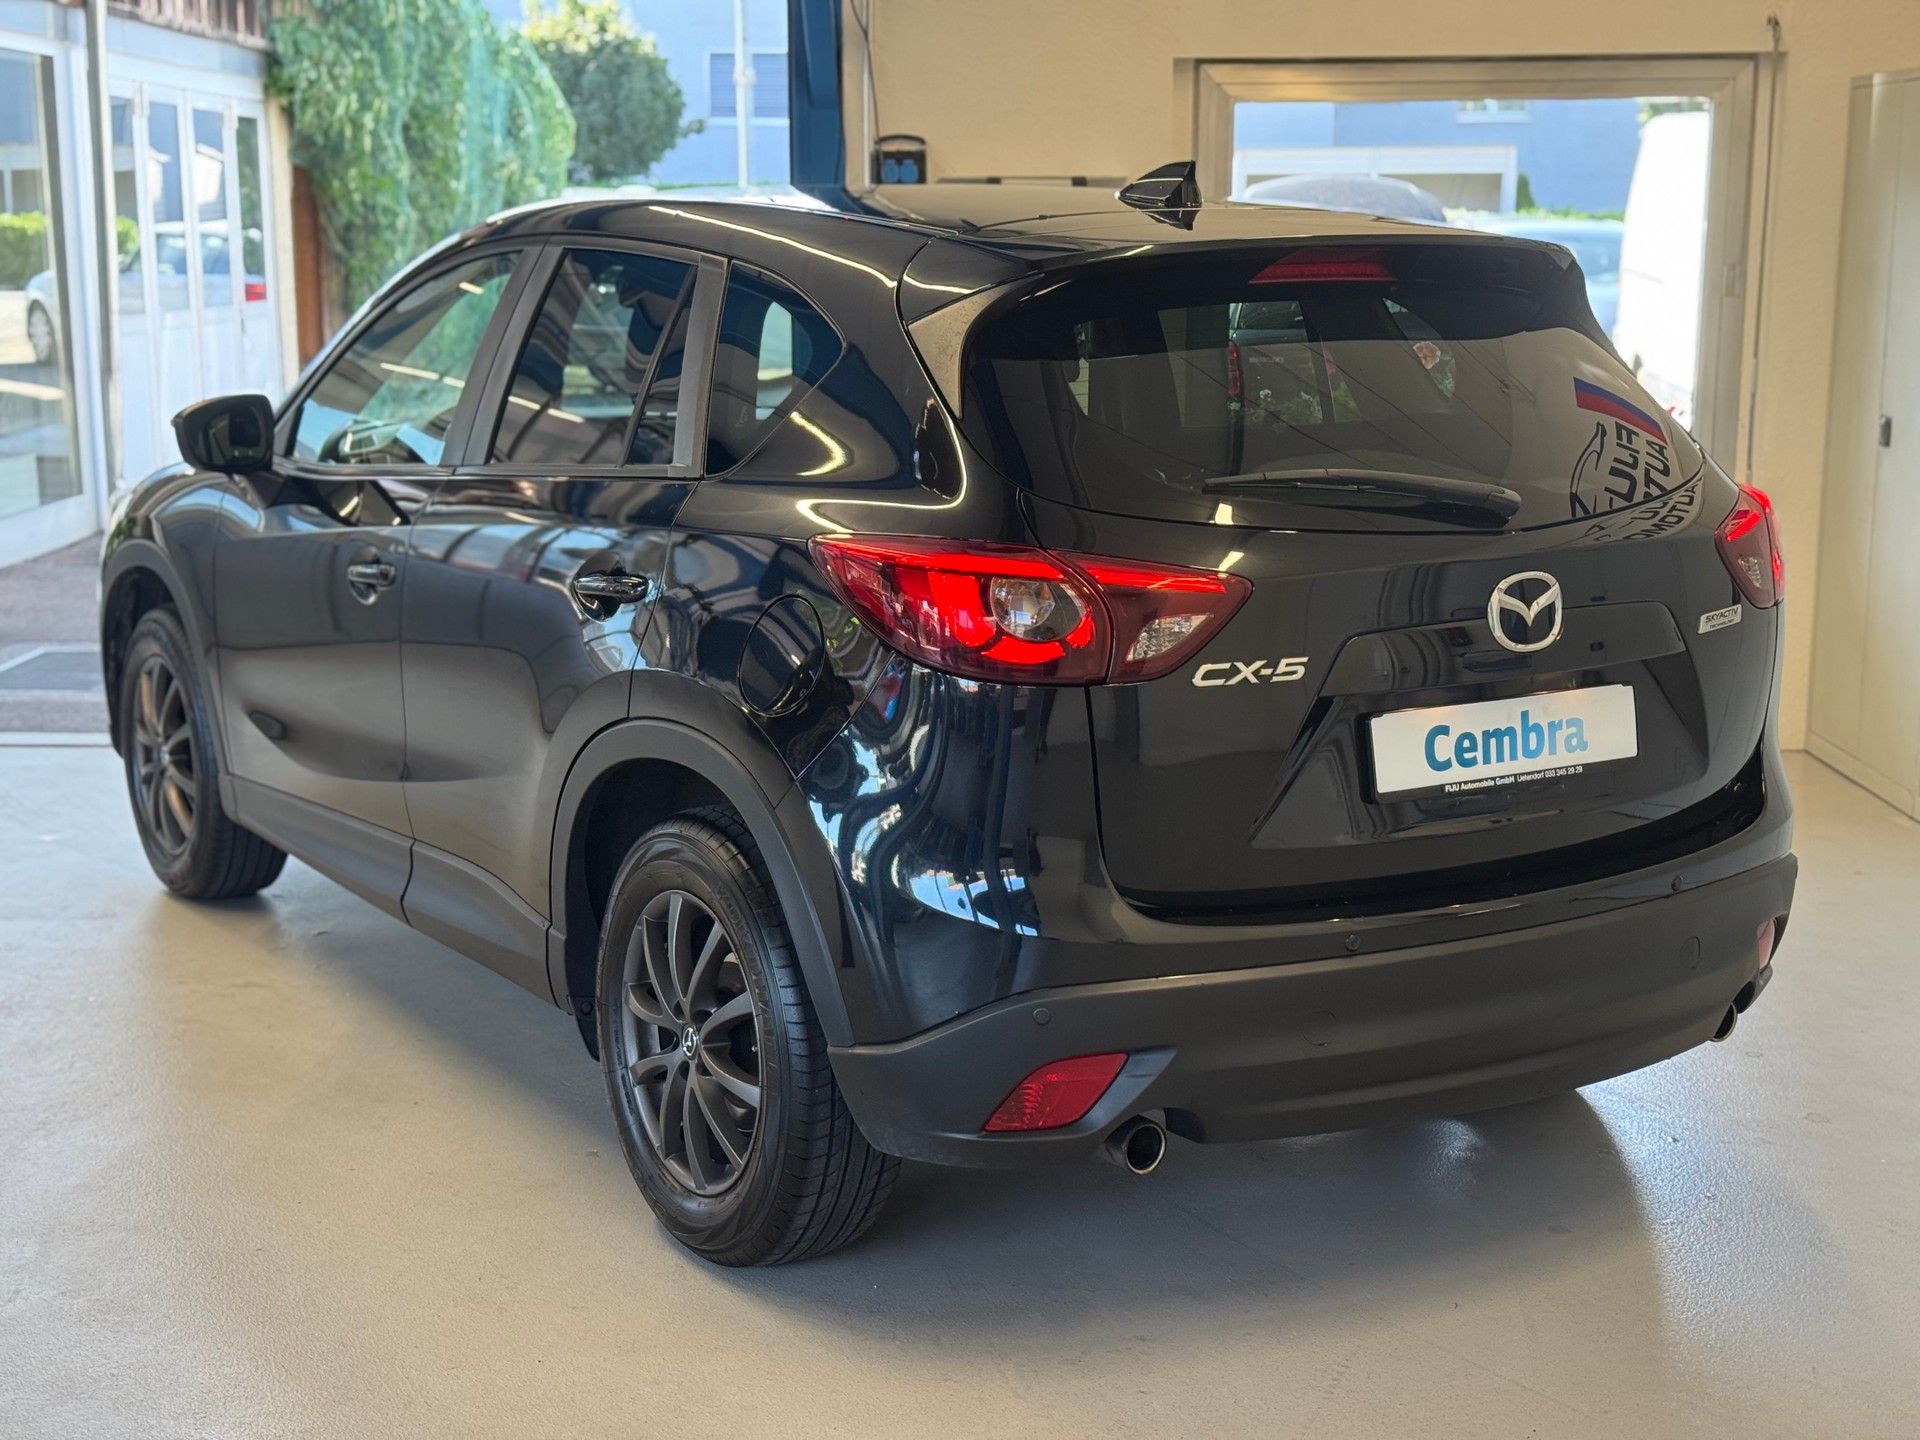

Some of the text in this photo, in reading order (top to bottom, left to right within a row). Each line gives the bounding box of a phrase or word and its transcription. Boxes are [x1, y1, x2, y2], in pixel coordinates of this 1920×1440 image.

[1192, 656, 1309, 687] CX-5
[1424, 709, 1589, 772] Cembra
[1460, 779, 1495, 791] Automobile
[1495, 775, 1515, 786] GmbH
